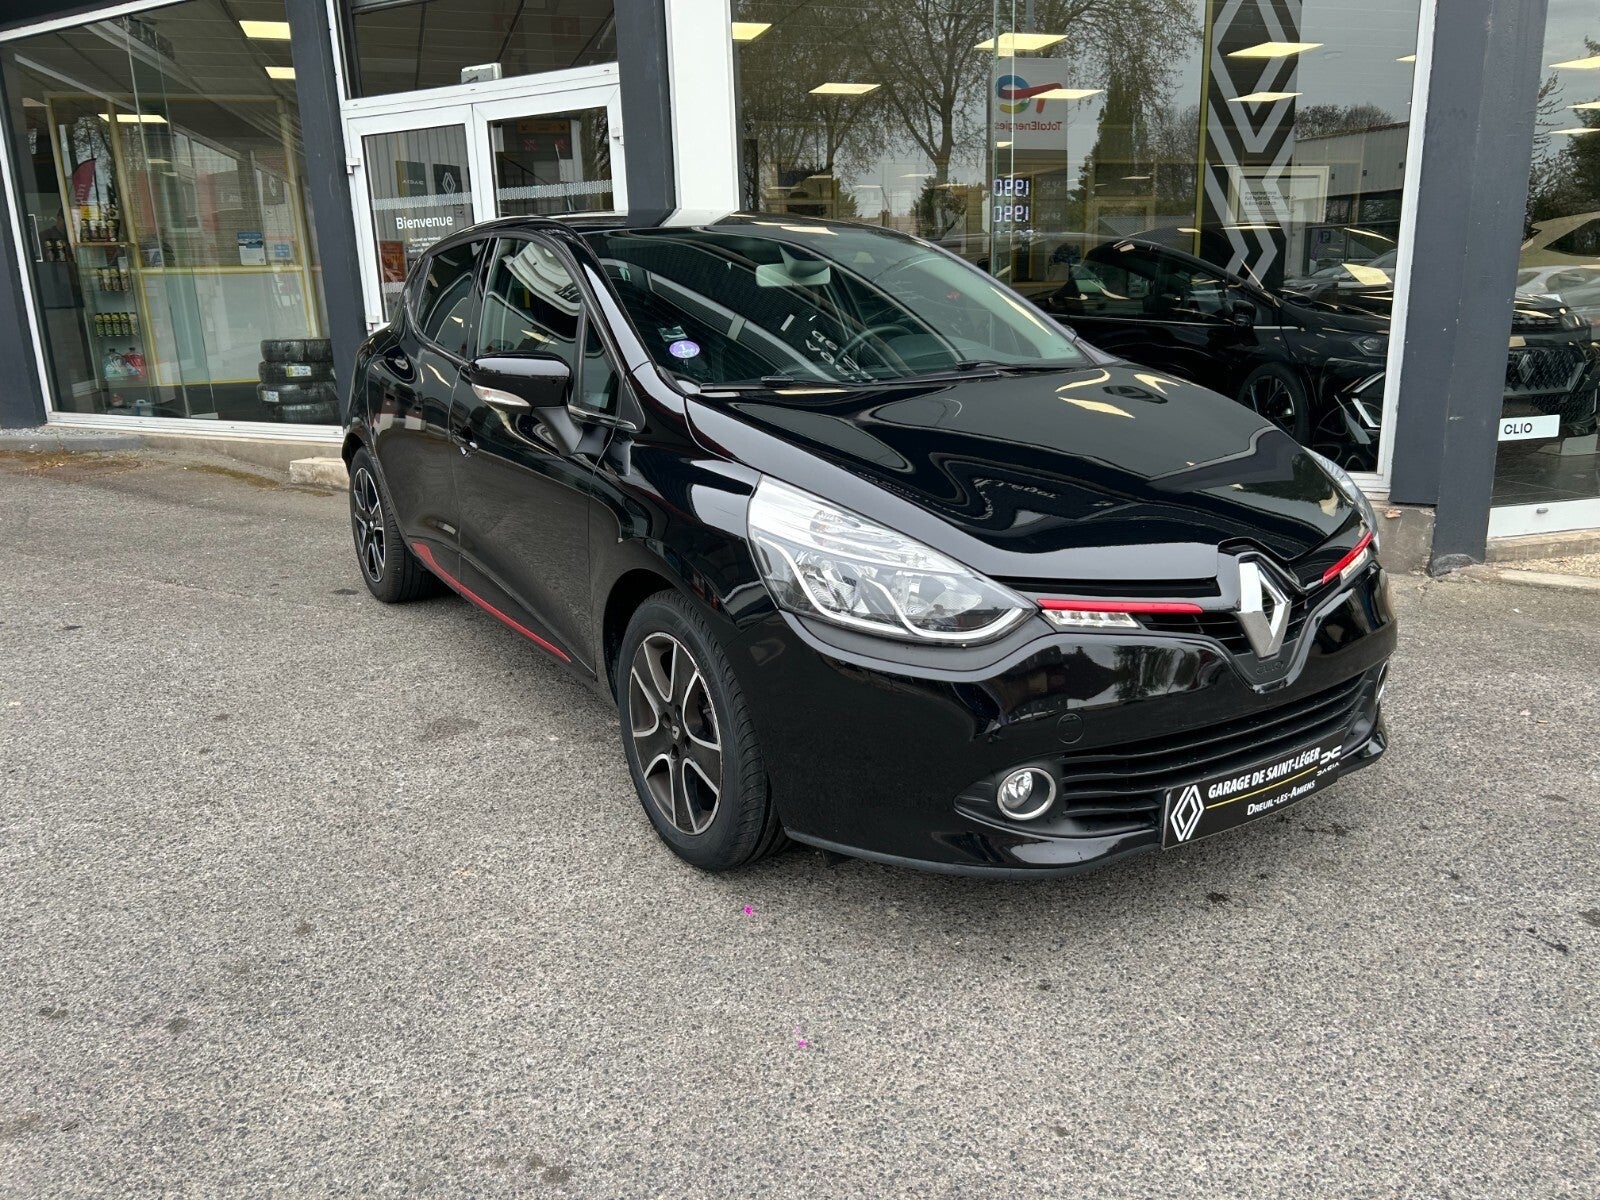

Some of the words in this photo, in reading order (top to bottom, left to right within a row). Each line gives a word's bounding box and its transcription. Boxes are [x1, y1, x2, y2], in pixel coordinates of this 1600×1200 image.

[395, 215, 454, 230] Bienvenue
[1503, 422, 1533, 435] CLIO
[1208, 774, 1251, 798] GARAGE
[1251, 769, 1266, 787] DE
[1265, 746, 1320, 782] SAINT-LÉGER
